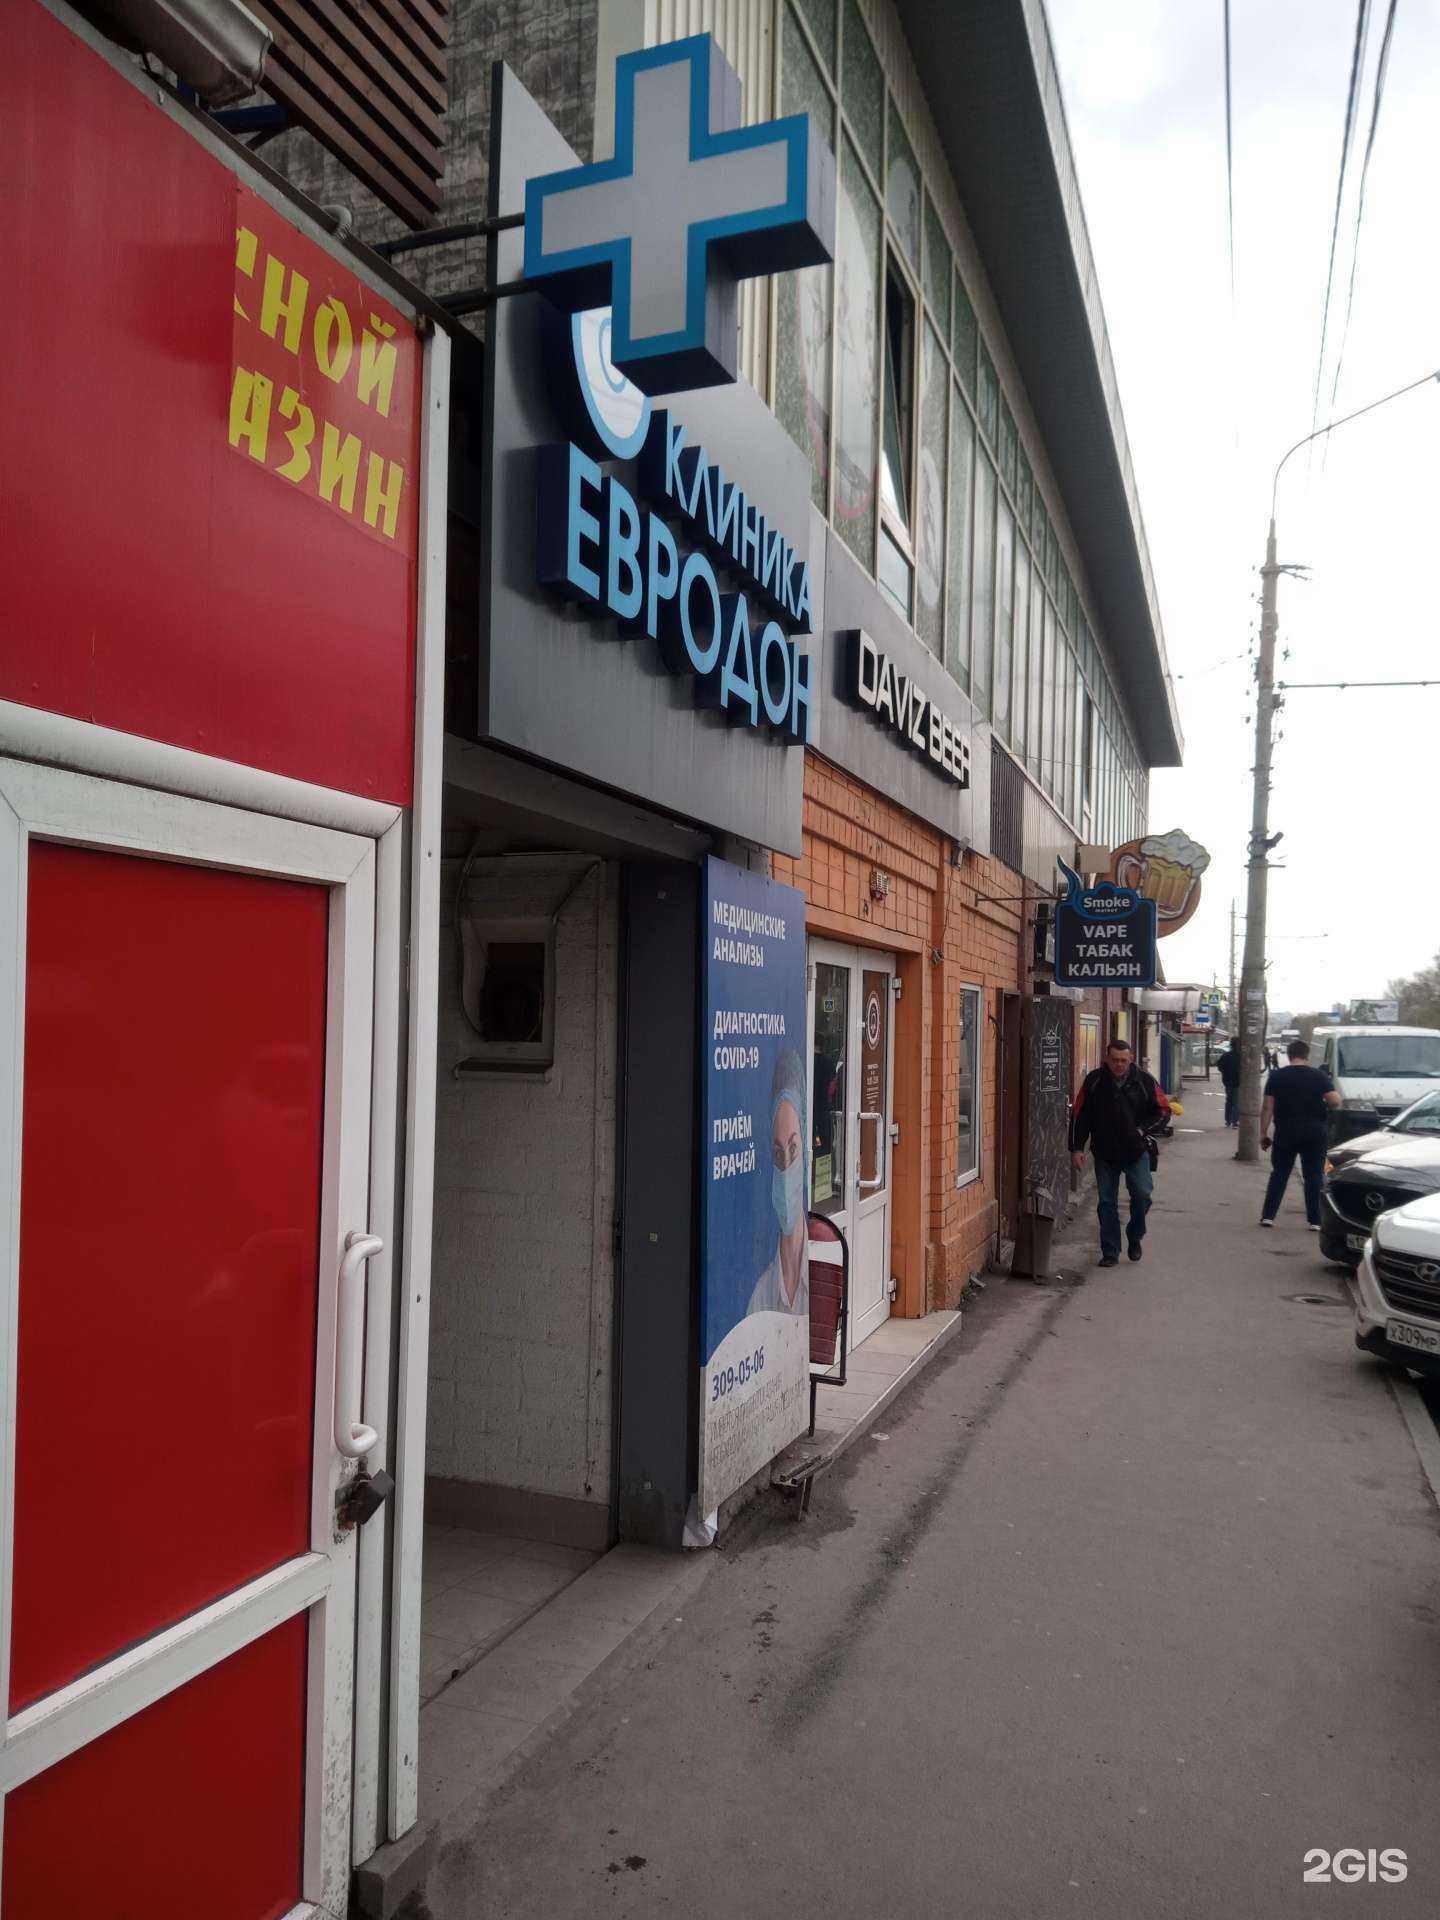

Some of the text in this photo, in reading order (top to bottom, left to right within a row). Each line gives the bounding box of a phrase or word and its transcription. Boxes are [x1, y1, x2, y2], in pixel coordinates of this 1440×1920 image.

[228, 366, 404, 540] АЗИН
[665, 408, 814, 634] КЛИНИКА
[567, 440, 813, 746] ЕВРОДОН
[858, 628, 927, 751] DAVIZ
[1083, 896, 1131, 908] Smoke
[713, 900, 786, 941] МЕДИЦИНСКИЕ
[1082, 924, 1128, 938] VAPE
[713, 936, 764, 968] АНАЛИЗЫ
[1076, 944, 1134, 957] ТАБАК
[1067, 963, 1141, 976] КАЛЬЯН
[713, 1010, 786, 1041] ДИАГНОСТИКА
[714, 1046, 760, 1071] COVID-19
[713, 1109, 752, 1143] ПРИЁМ
[713, 1142, 755, 1181] ВРАЧЕЙ
[712, 1346, 765, 1402] 309-05-06
